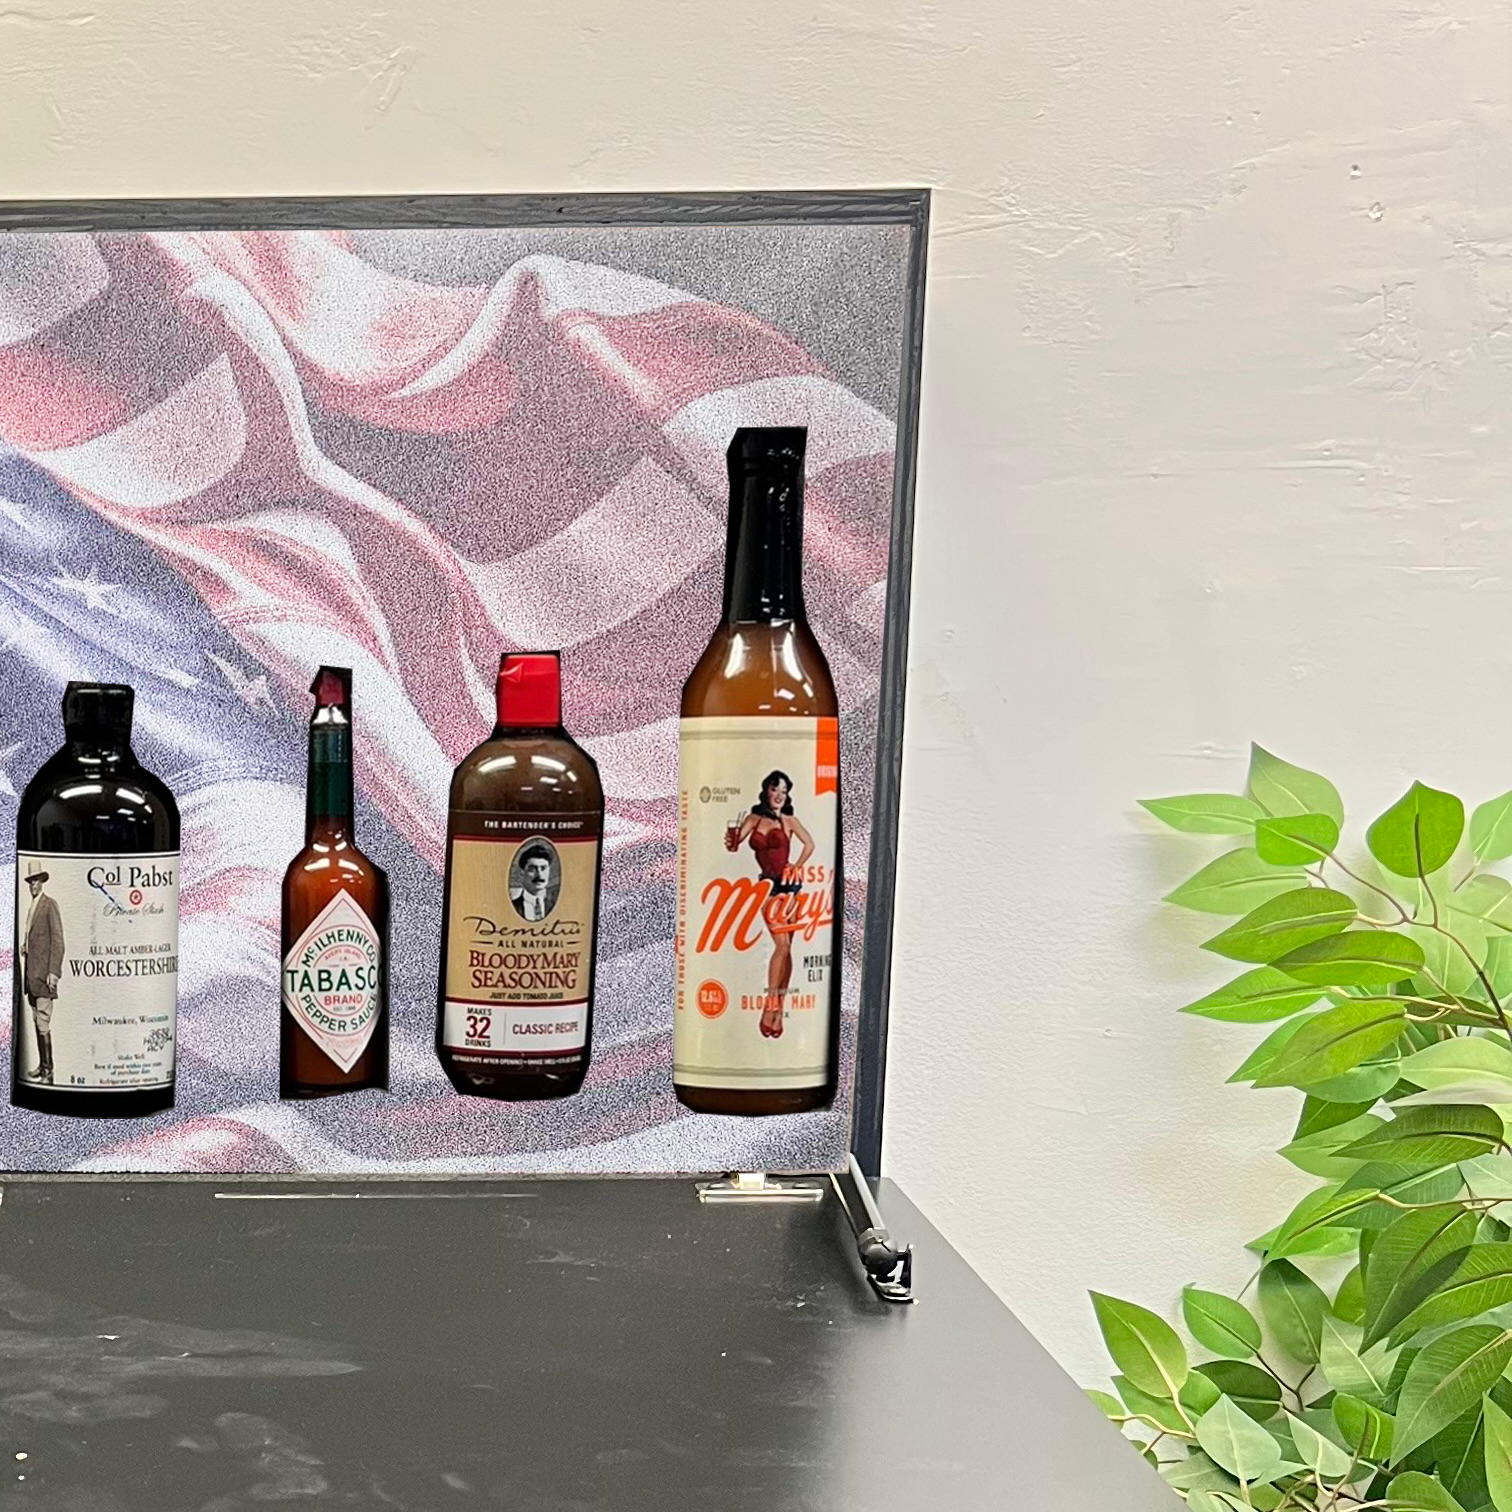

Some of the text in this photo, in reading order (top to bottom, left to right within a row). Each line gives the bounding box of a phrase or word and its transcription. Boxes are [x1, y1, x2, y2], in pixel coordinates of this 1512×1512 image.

[87, 864, 174, 888] Col Pabst
[781, 866, 825, 886] MISS
[497, 940, 565, 948] ALL NATURAL
[469, 950, 581, 969] BLOODY MARY
[471, 968, 577, 989] SEASONING
[324, 993, 363, 1006] BRAND
[301, 993, 347, 1031] PEPPER
[467, 1007, 492, 1016] MAKES
[465, 1015, 492, 1039] 32
[512, 1021, 579, 1035] CLASSIC RECIPE
[465, 1038, 492, 1048] DRINKS
